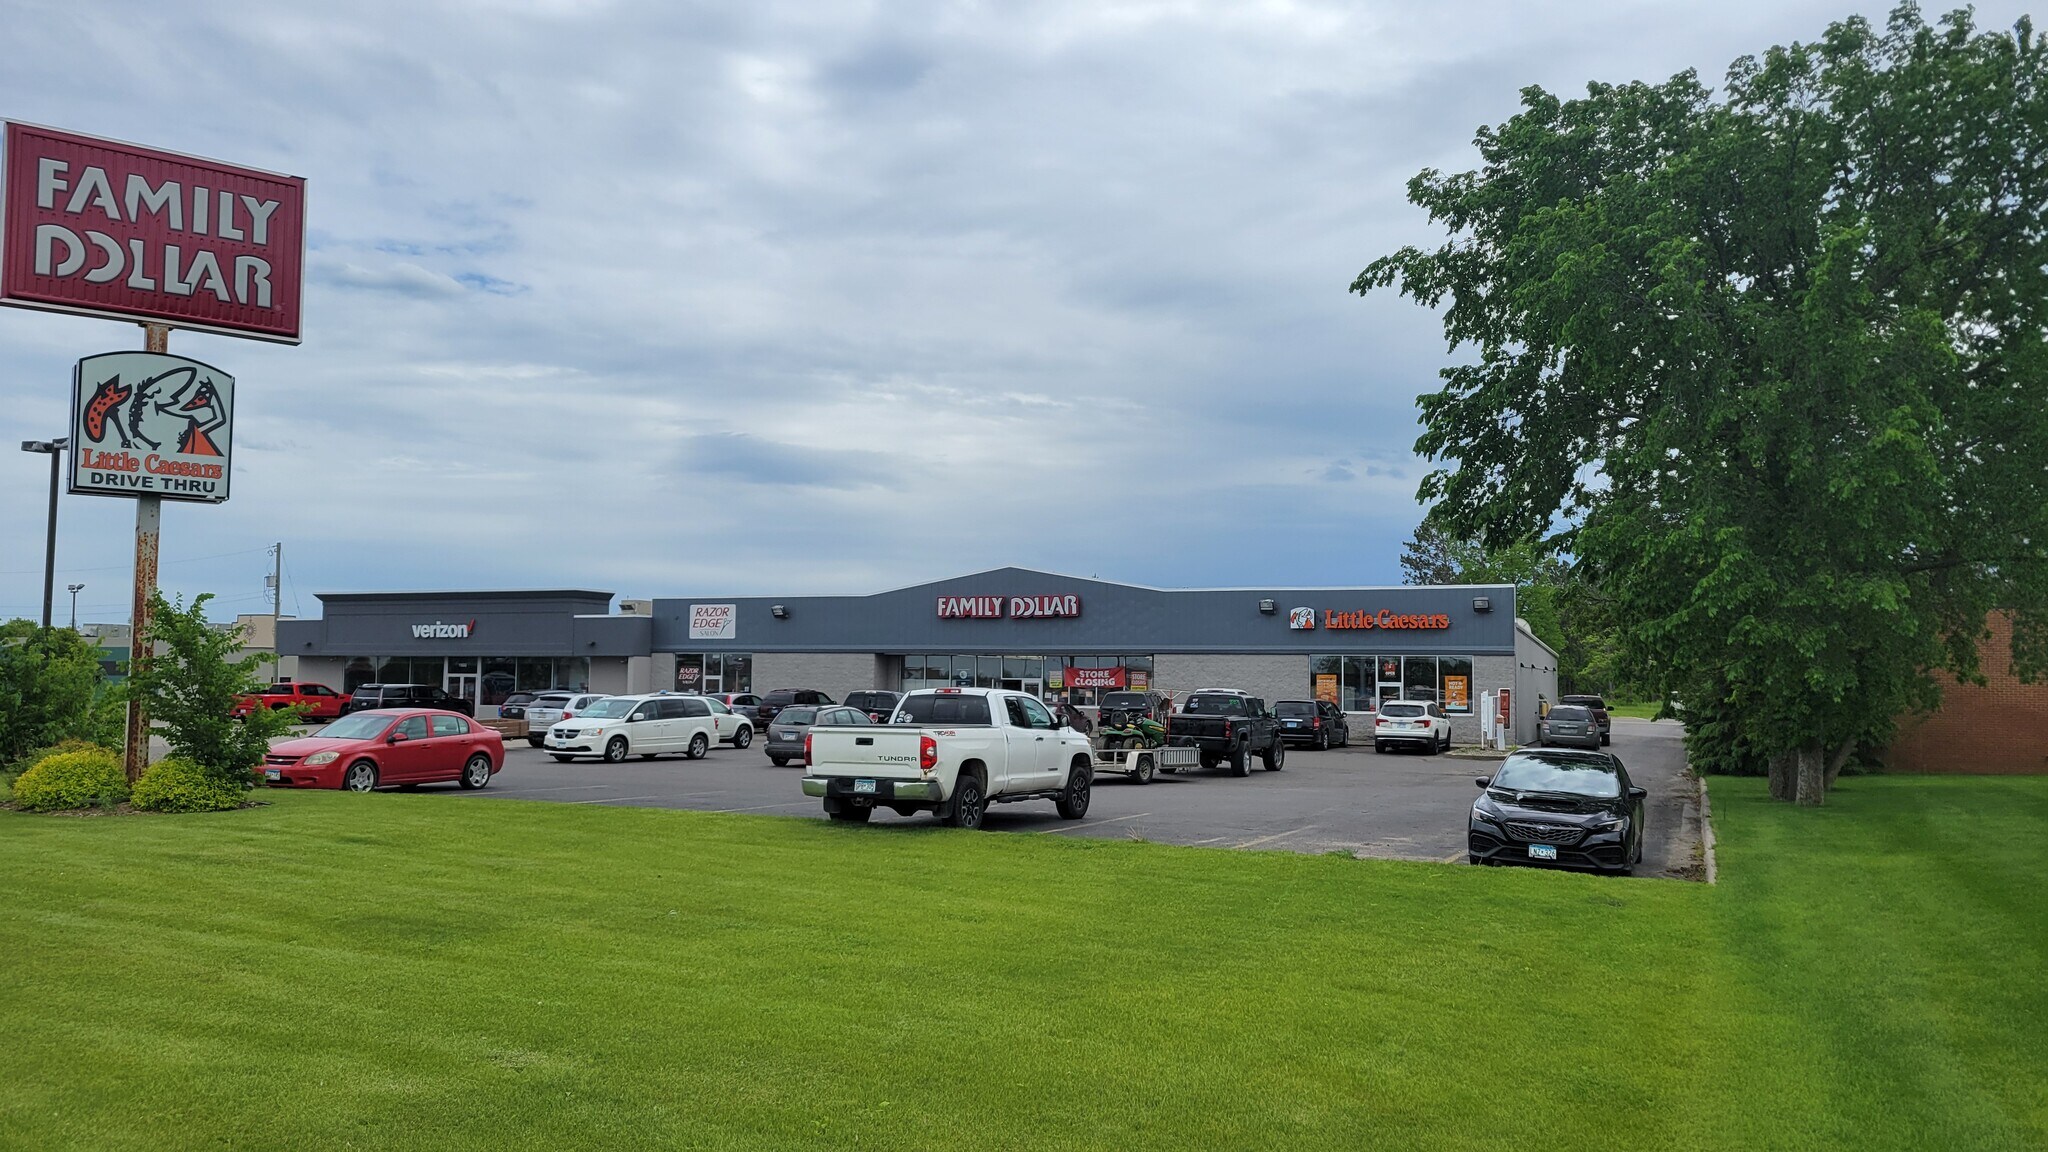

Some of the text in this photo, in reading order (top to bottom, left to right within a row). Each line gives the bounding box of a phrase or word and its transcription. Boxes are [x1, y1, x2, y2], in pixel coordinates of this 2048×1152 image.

[37, 157, 281, 246] FAMILY
[34, 224, 273, 308] DOLLAR
[81, 448, 223, 479] Little Caesars
[91, 472, 215, 493] DRIVE THRU
[695, 607, 730, 617] RAZOR
[937, 595, 1078, 616] FAMILY DOLLAR
[411, 620, 468, 638] verizon
[693, 618, 723, 628] EDGE
[1324, 609, 1449, 629] Little Caesars
[1074, 678, 1116, 687] CLOSING
[1080, 670, 1110, 678] STORE
